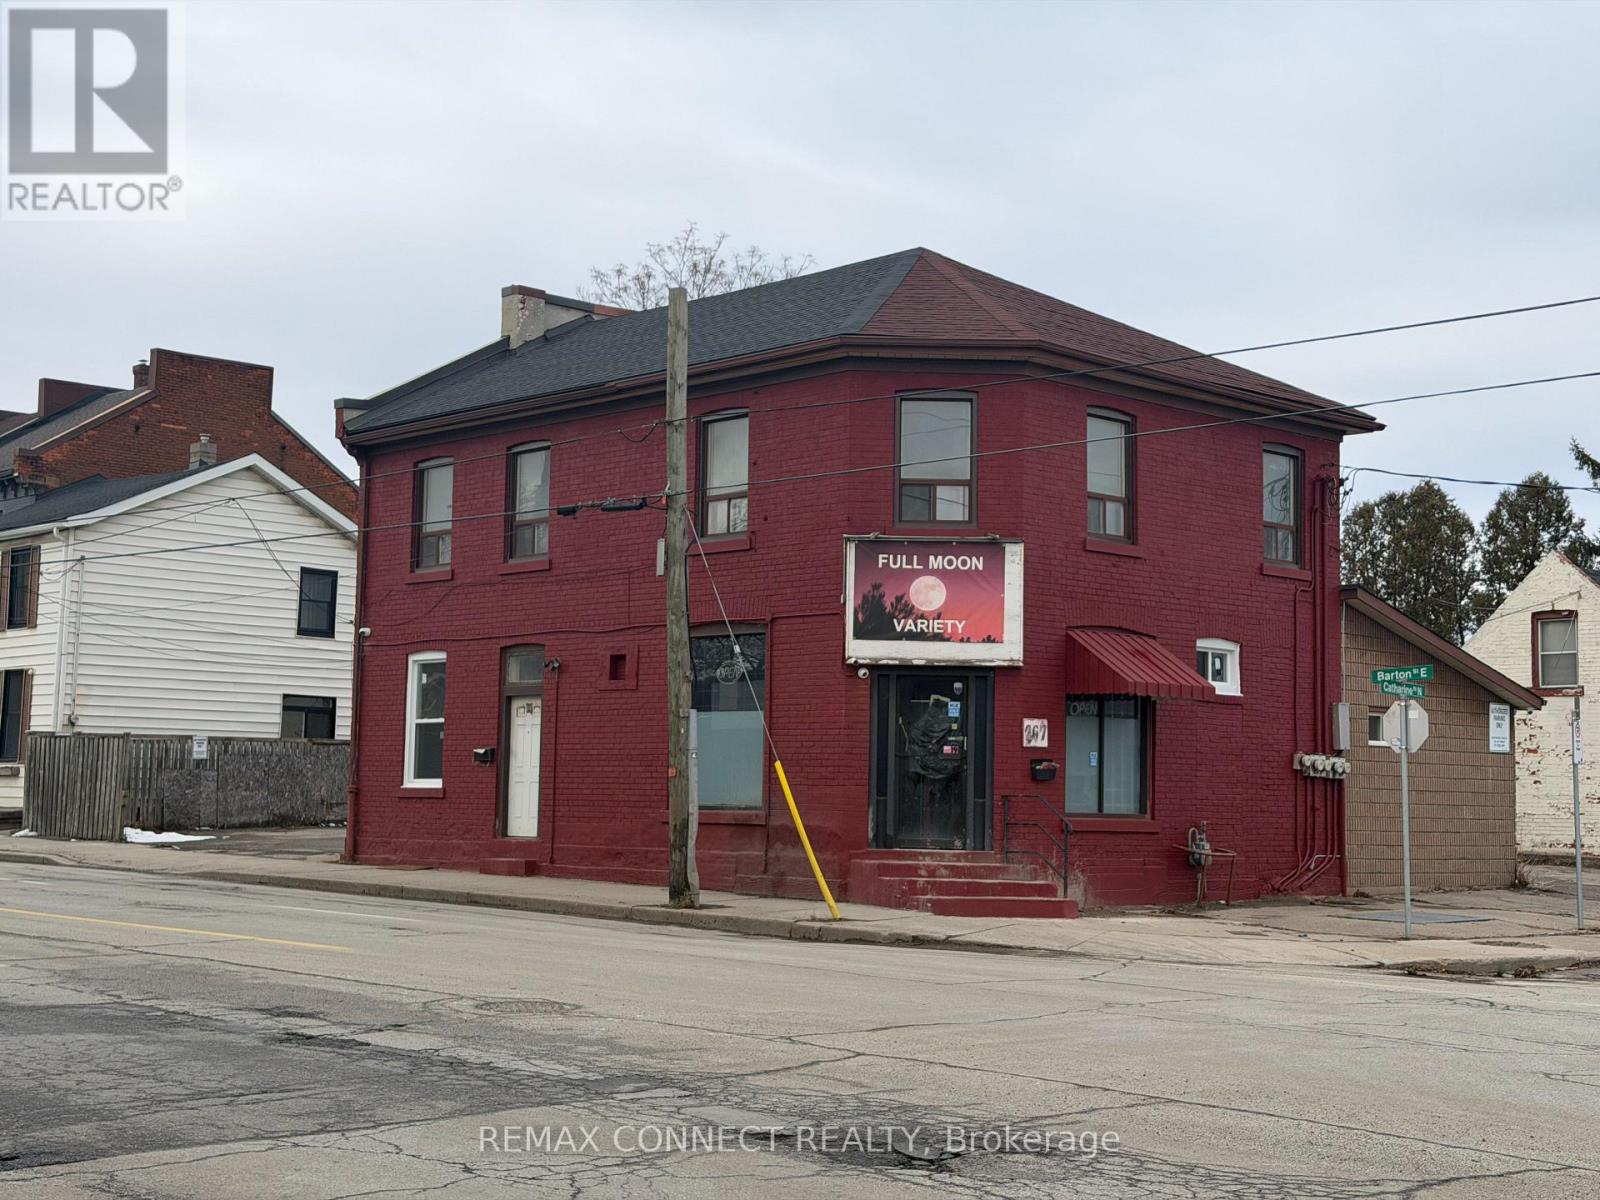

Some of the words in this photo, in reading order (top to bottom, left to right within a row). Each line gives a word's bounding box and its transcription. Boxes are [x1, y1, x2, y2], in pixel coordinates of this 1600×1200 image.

[878, 554, 923, 569] FULL
[928, 555, 984, 571] MOON
[893, 618, 966, 633] VARIETY
[1377, 670, 1411, 681] Barton
[1421, 667, 1427, 677] E
[1070, 702, 1098, 716] OPEN
